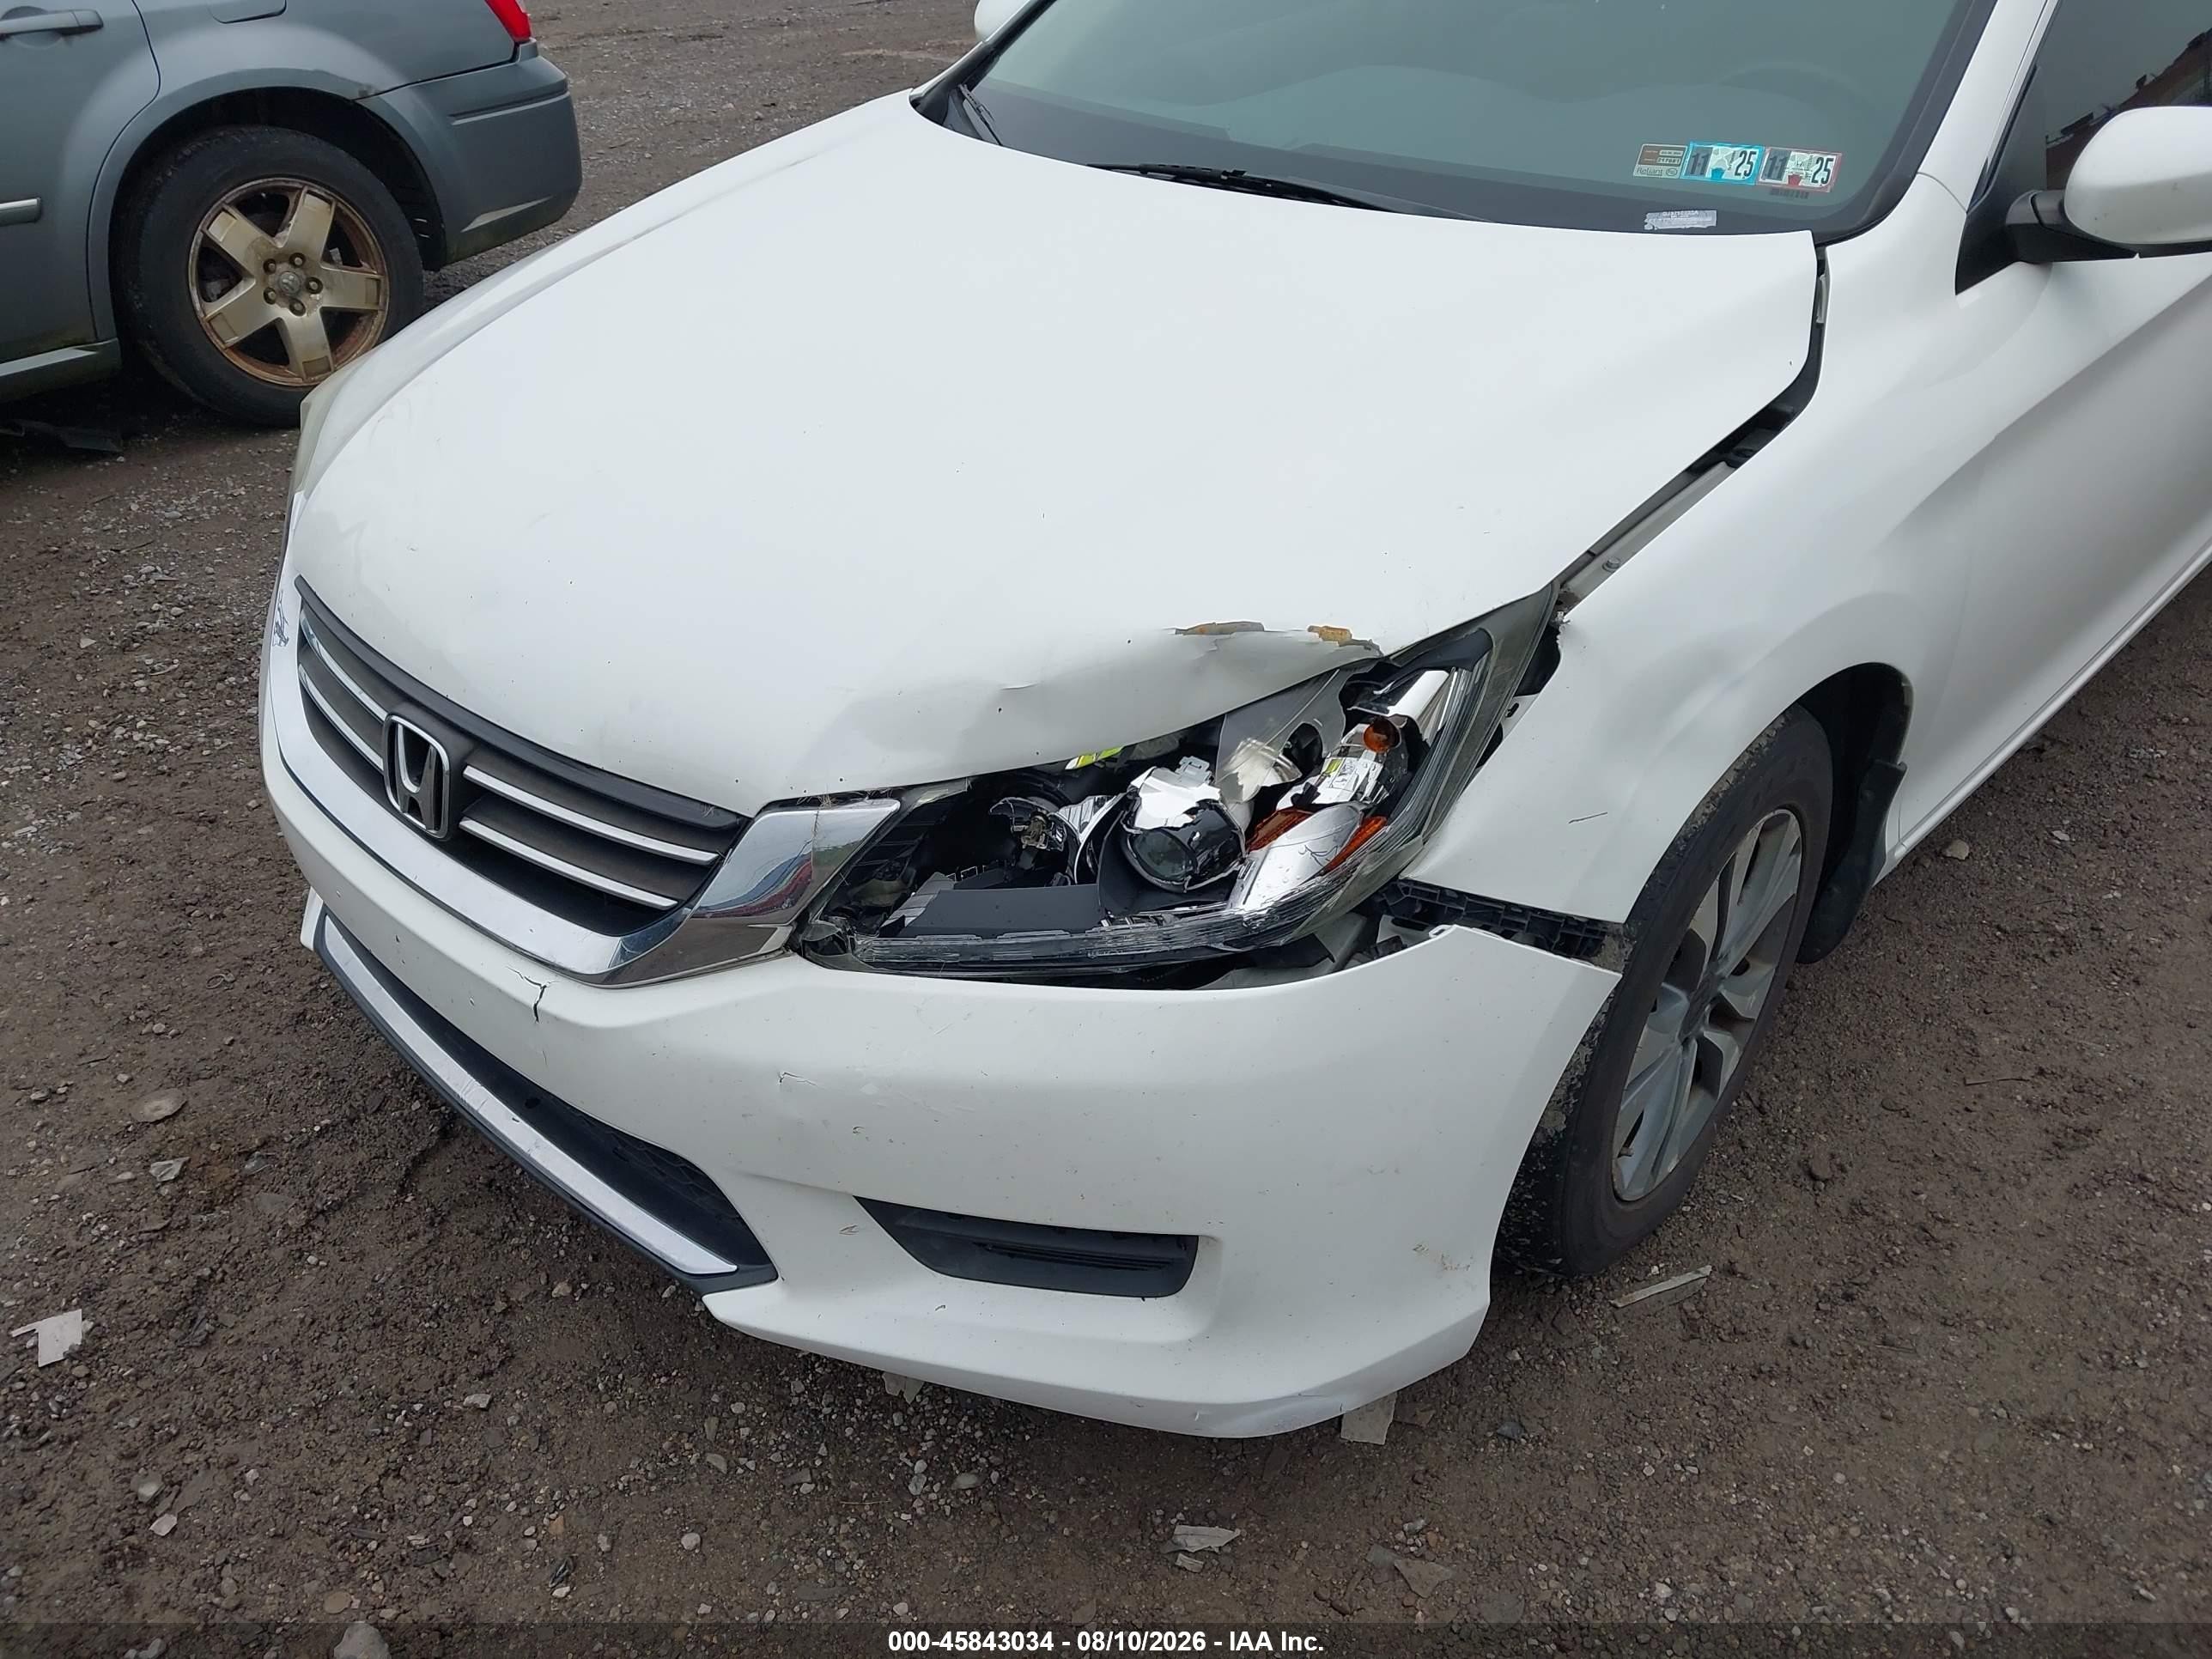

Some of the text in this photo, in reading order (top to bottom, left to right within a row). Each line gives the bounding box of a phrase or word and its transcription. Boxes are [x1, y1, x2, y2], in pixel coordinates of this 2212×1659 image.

[1688, 152, 1710, 176] 11
[1734, 149, 1757, 177] 25
[1764, 155, 1789, 180] 11
[1810, 156, 1834, 185] 25
